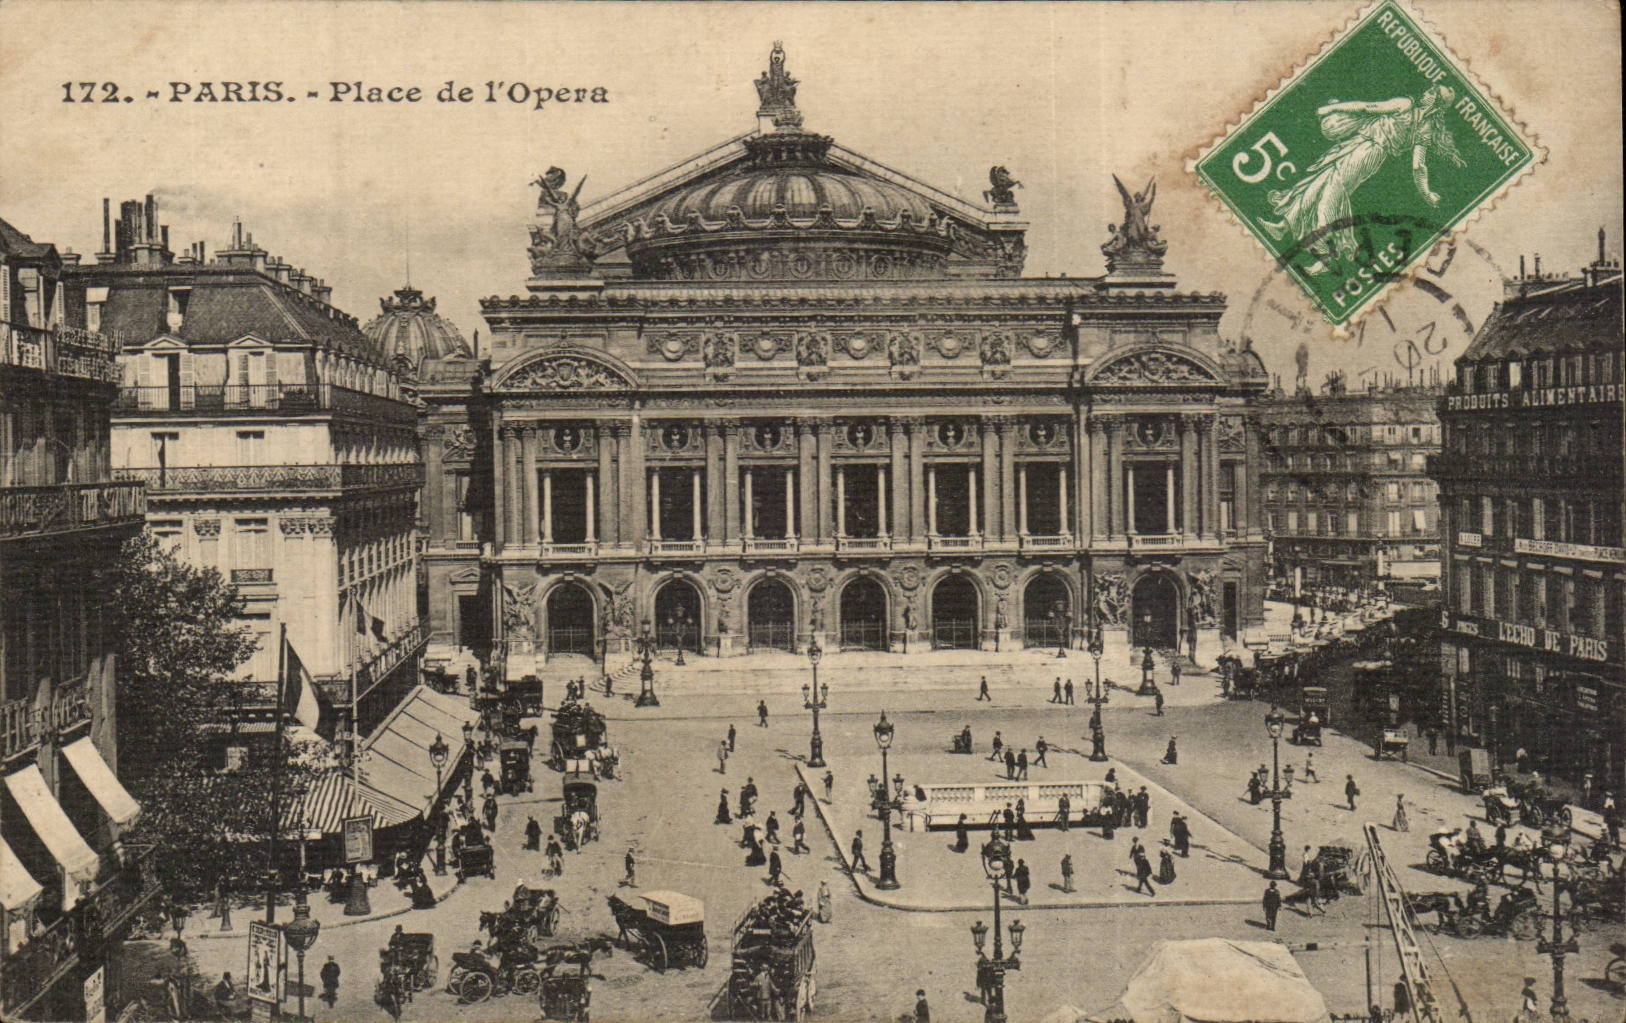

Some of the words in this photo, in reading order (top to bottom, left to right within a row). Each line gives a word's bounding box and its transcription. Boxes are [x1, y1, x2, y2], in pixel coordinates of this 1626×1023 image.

[1377, 10, 1448, 83] REPUBLIQUE
[1454, 96, 1520, 167] FRANÇAISE
[1447, 392, 1509, 411] PRODUITS
[1544, 629, 1561, 652] DE
[1568, 634, 1608, 662] PARIS
